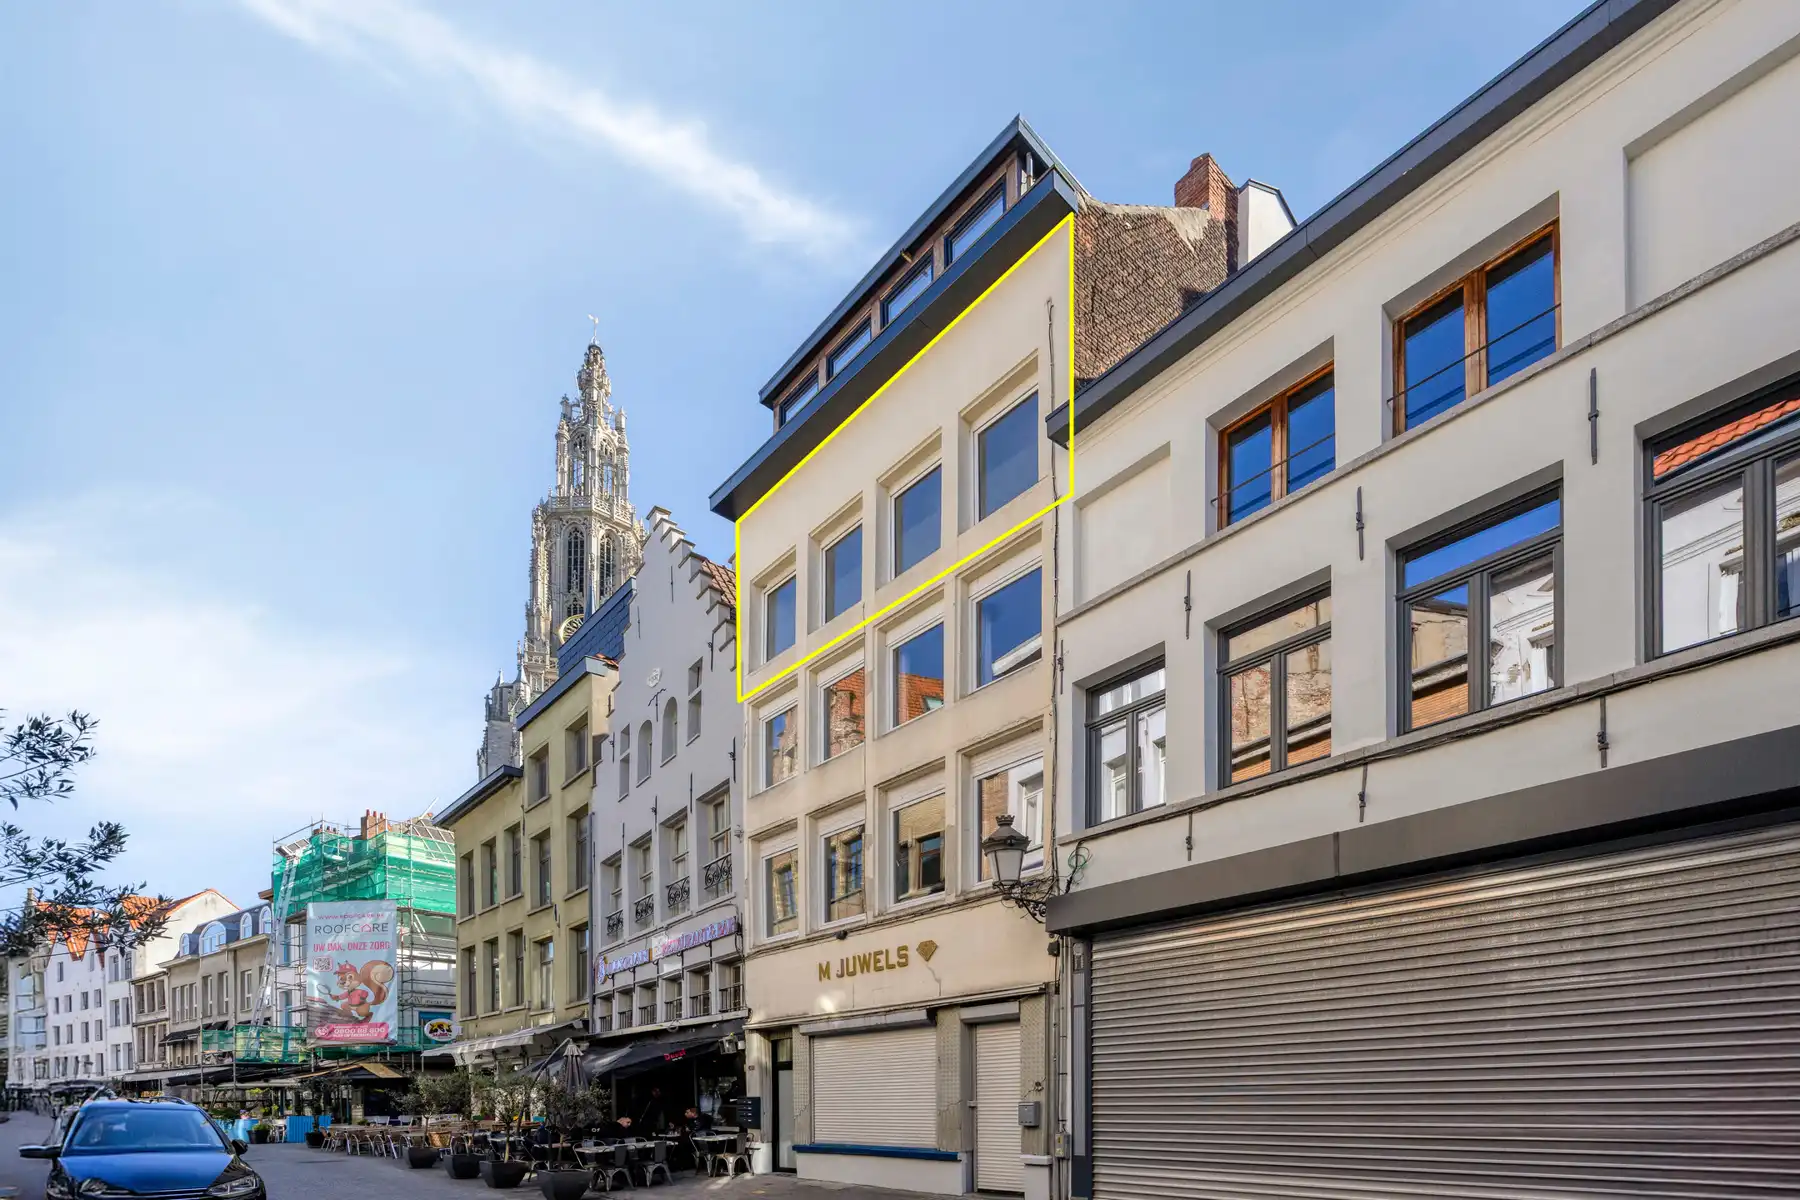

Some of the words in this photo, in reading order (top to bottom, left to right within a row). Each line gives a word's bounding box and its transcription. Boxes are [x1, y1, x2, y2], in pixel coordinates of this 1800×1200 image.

[313, 943, 325, 952] UW
[327, 942, 346, 952] DAK,
[347, 942, 368, 951] ONZE
[369, 941, 391, 950] ZORG
[818, 961, 831, 982] M
[836, 945, 909, 978] JUWELS
